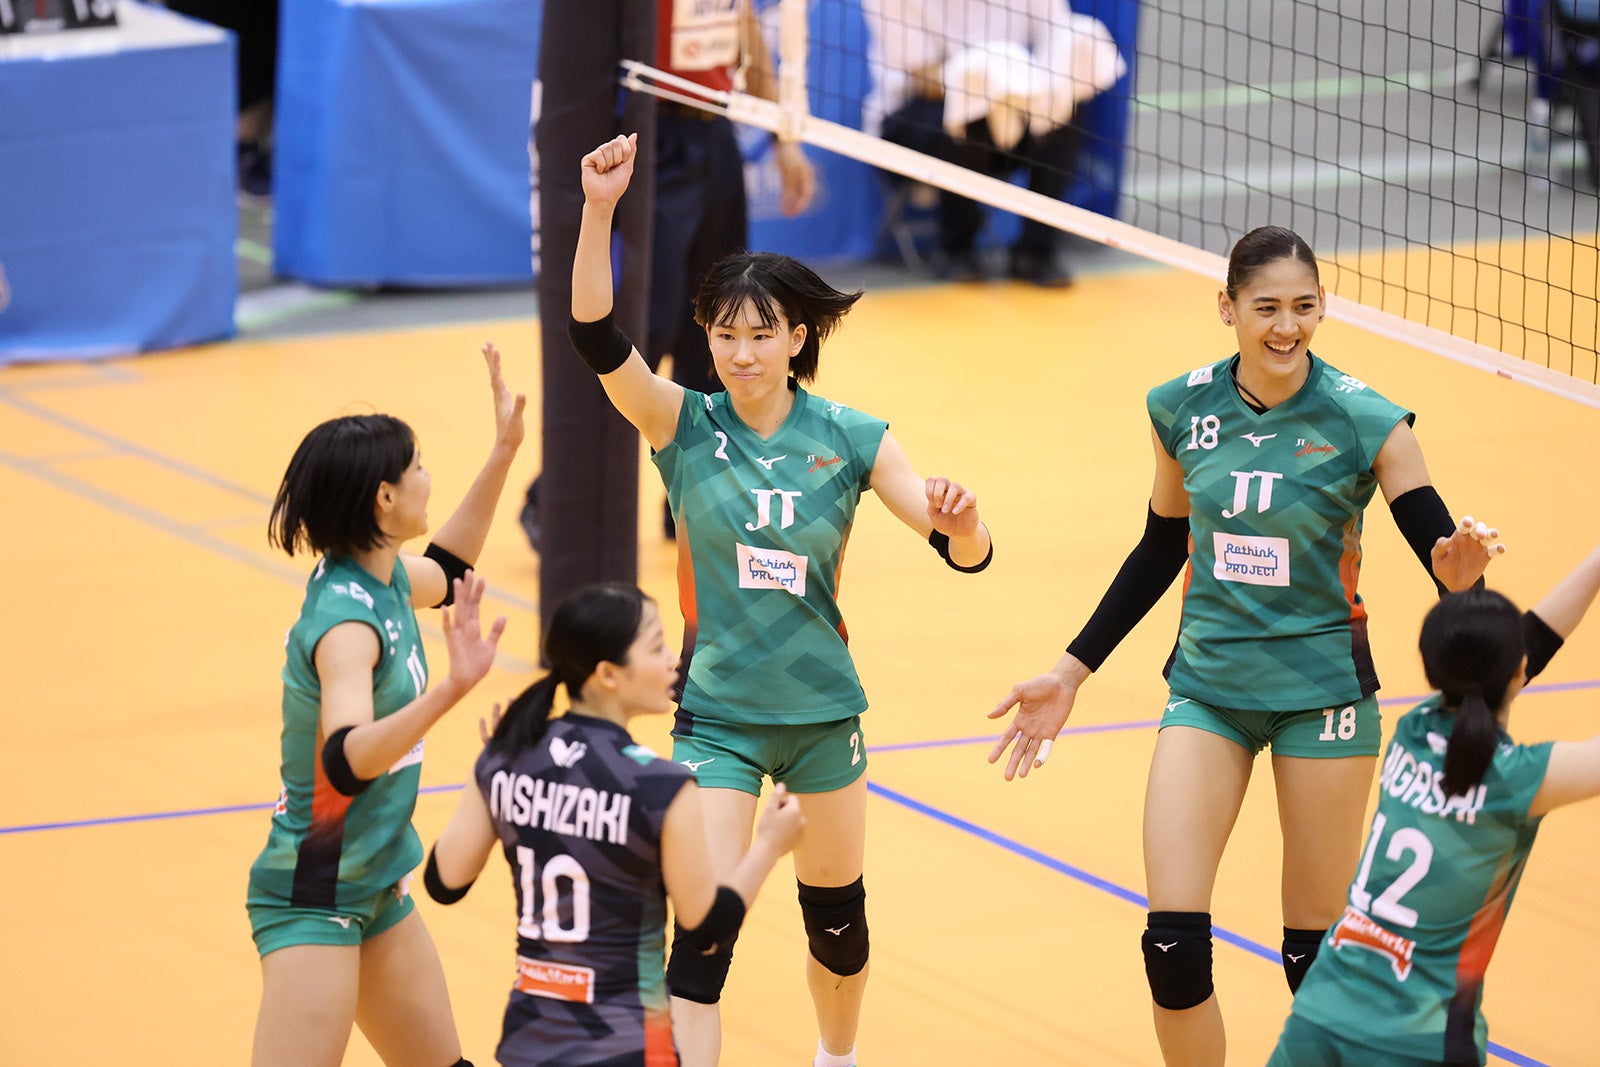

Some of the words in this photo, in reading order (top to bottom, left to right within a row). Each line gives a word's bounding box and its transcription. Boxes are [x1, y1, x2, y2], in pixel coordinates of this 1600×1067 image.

[714, 430, 730, 462] 2
[1186, 414, 1221, 450] 18
[744, 488, 803, 532] JT
[1220, 470, 1284, 519] JT
[1226, 542, 1275, 558] Rethink
[1225, 562, 1277, 577] PROJECT
[1318, 706, 1357, 742] 18
[849, 731, 862, 766] 2
[490, 768, 632, 846] NISHIZAKI
[1350, 812, 1434, 929] 12
[516, 845, 591, 943] 10
